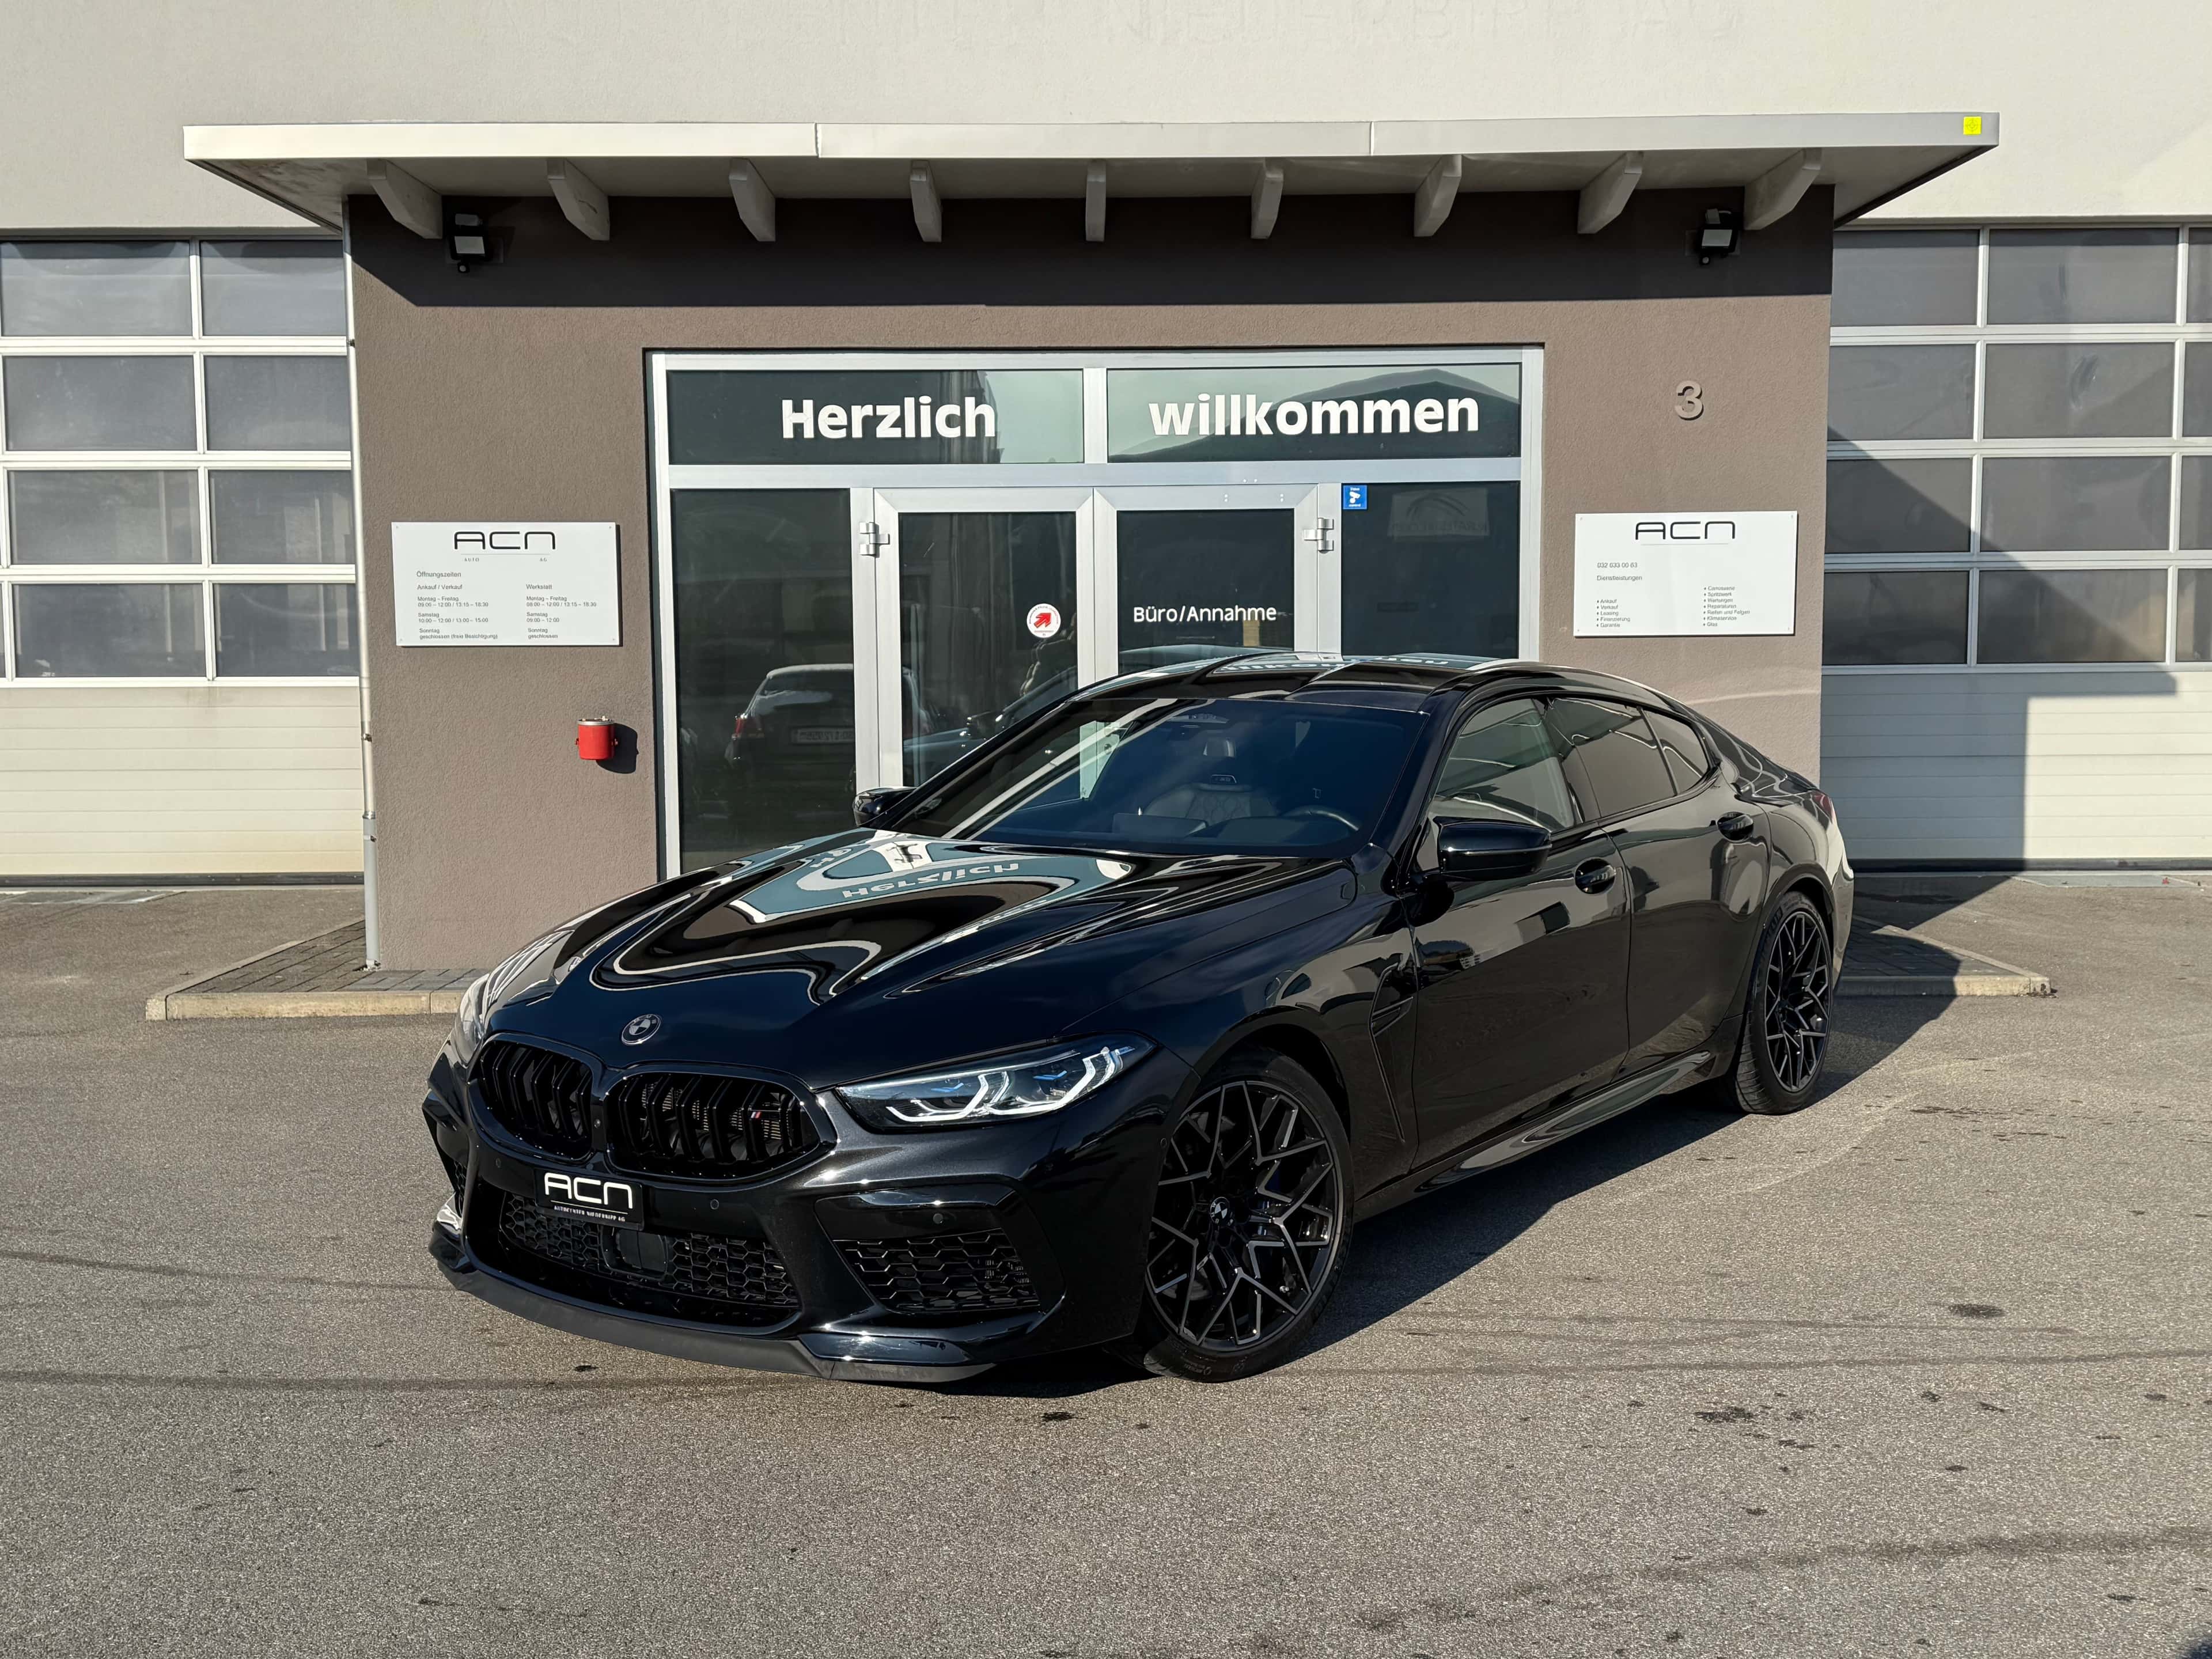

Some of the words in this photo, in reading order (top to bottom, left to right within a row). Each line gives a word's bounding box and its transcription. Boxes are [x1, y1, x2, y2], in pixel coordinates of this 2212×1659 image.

[782, 396, 996, 439] Herzlich
[1148, 393, 1479, 435] willkommen
[1675, 380, 1703, 420] 3
[454, 531, 556, 550] ACN
[1635, 521, 1736, 540] ACN
[1133, 605, 1277, 622] Büro/Annahme
[544, 1172, 633, 1209] ACN
